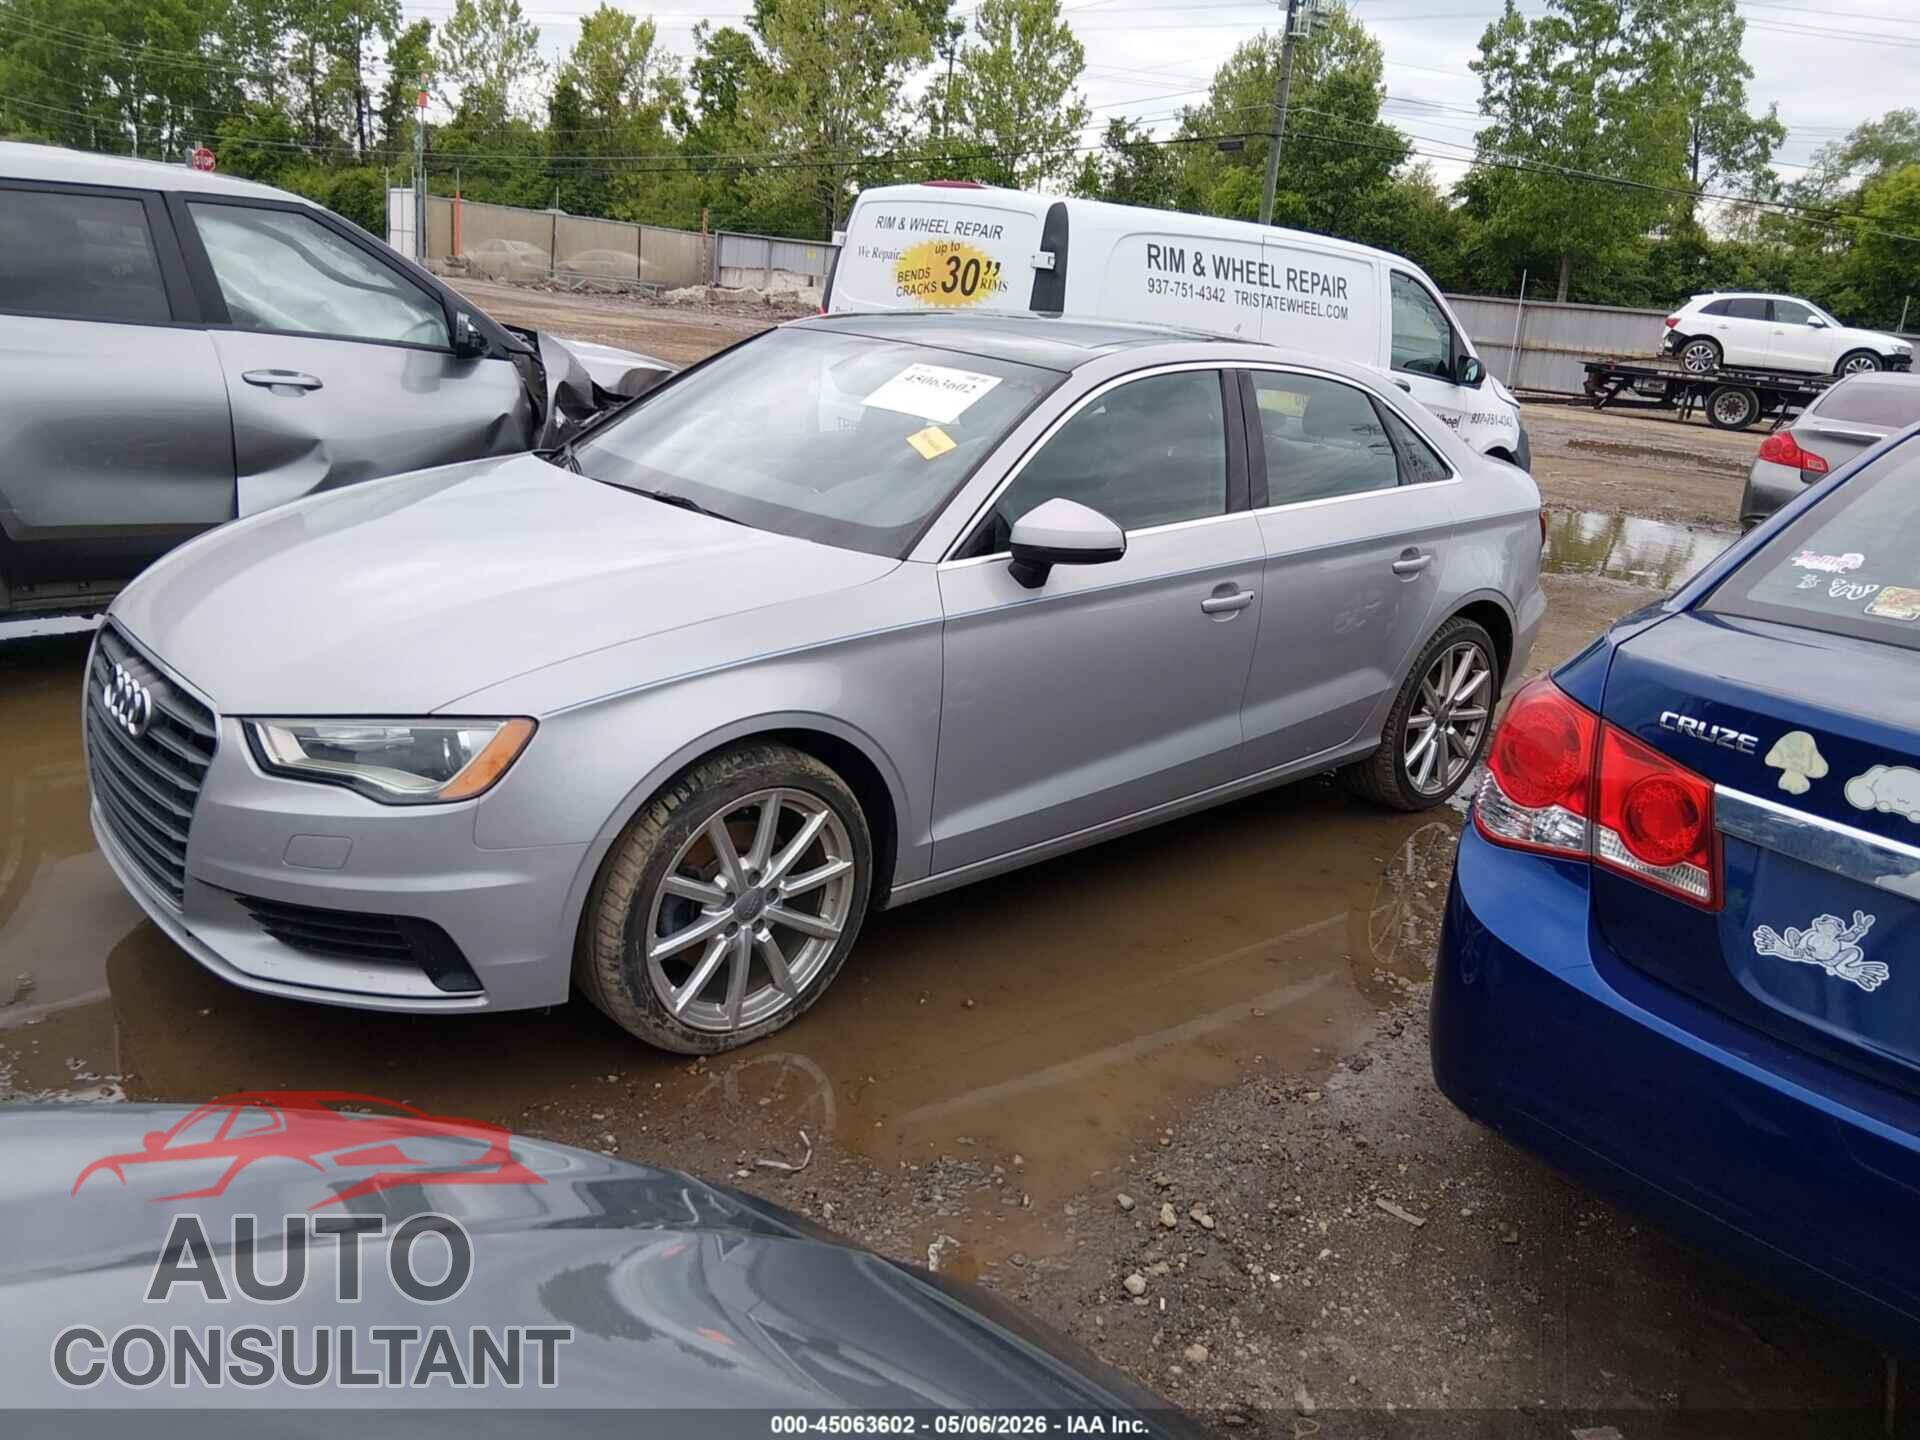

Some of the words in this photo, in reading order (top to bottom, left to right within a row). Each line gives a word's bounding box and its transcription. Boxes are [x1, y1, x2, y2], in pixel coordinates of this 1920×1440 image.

[194, 155, 215, 167] STOP
[875, 215, 896, 231] RIM
[897, 217, 906, 231] &
[909, 217, 950, 234] WHEEL
[954, 221, 1003, 240] REPAIR
[858, 245, 871, 259] We
[935, 241, 949, 255] up
[950, 240, 961, 252] to
[897, 267, 931, 283] BENDS
[1147, 243, 1186, 274] RIM
[1192, 251, 1206, 277] &
[1212, 254, 1281, 289] WHEEL
[1286, 267, 1348, 300] REPAIR
[896, 281, 937, 297] CRACKS
[980, 277, 1008, 294] RIMS
[1147, 277, 1225, 303] 937-751-4342
[1234, 289, 1349, 321] TRISTATEWHEEL.COM
[1659, 711, 1759, 755] CRUZE
